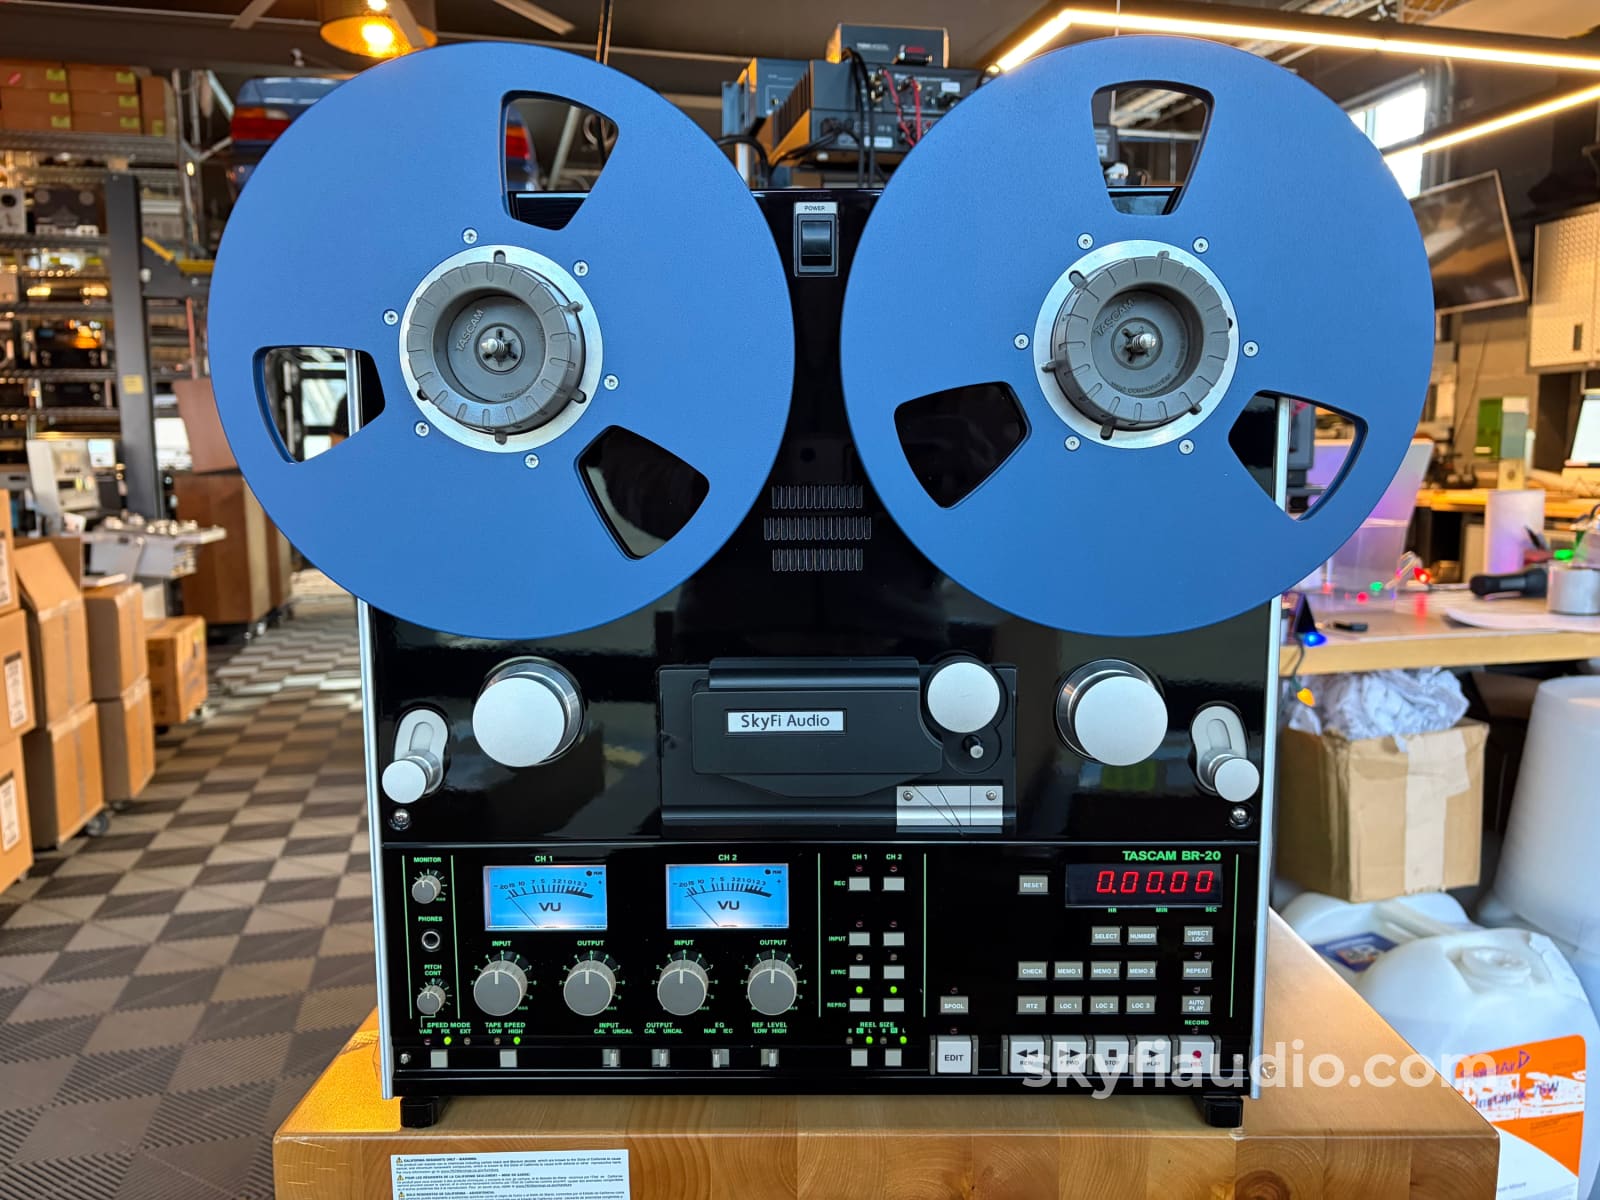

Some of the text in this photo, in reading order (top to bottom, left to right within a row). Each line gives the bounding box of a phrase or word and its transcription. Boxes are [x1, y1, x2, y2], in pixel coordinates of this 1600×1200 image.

[1095, 297, 1137, 337] TASCAM
[456, 309, 484, 352] TASCAM
[740, 713, 830, 729] SkyFi Audio
[1122, 850, 1222, 861] TASCAM BR-20
[538, 902, 562, 912] VU
[717, 900, 740, 911] VU
[944, 1054, 964, 1062] EDIT
